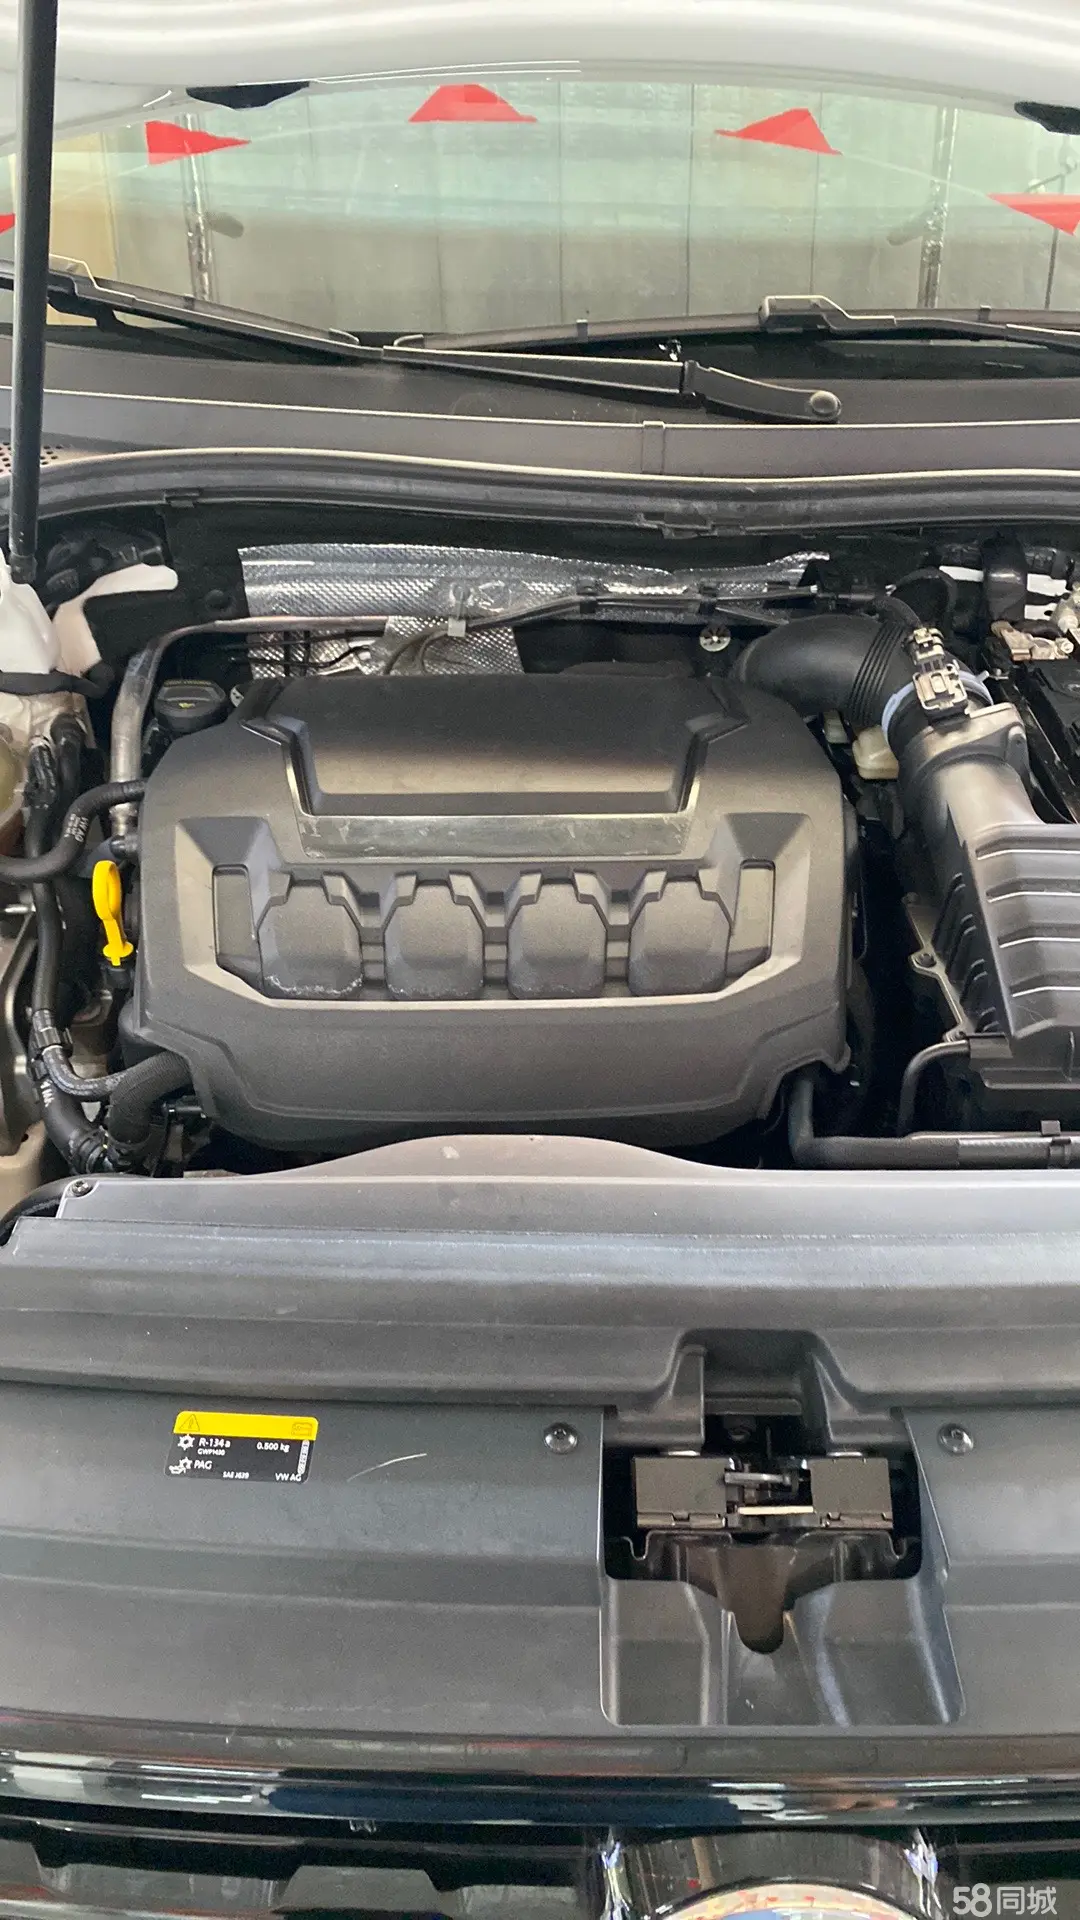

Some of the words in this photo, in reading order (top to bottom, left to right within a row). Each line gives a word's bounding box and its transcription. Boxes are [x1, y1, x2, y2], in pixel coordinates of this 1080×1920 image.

[280, 1442, 290, 1453] kg
[193, 1460, 213, 1470] PAG
[275, 1472, 289, 1481] VW
[289, 1473, 302, 1482] AG
